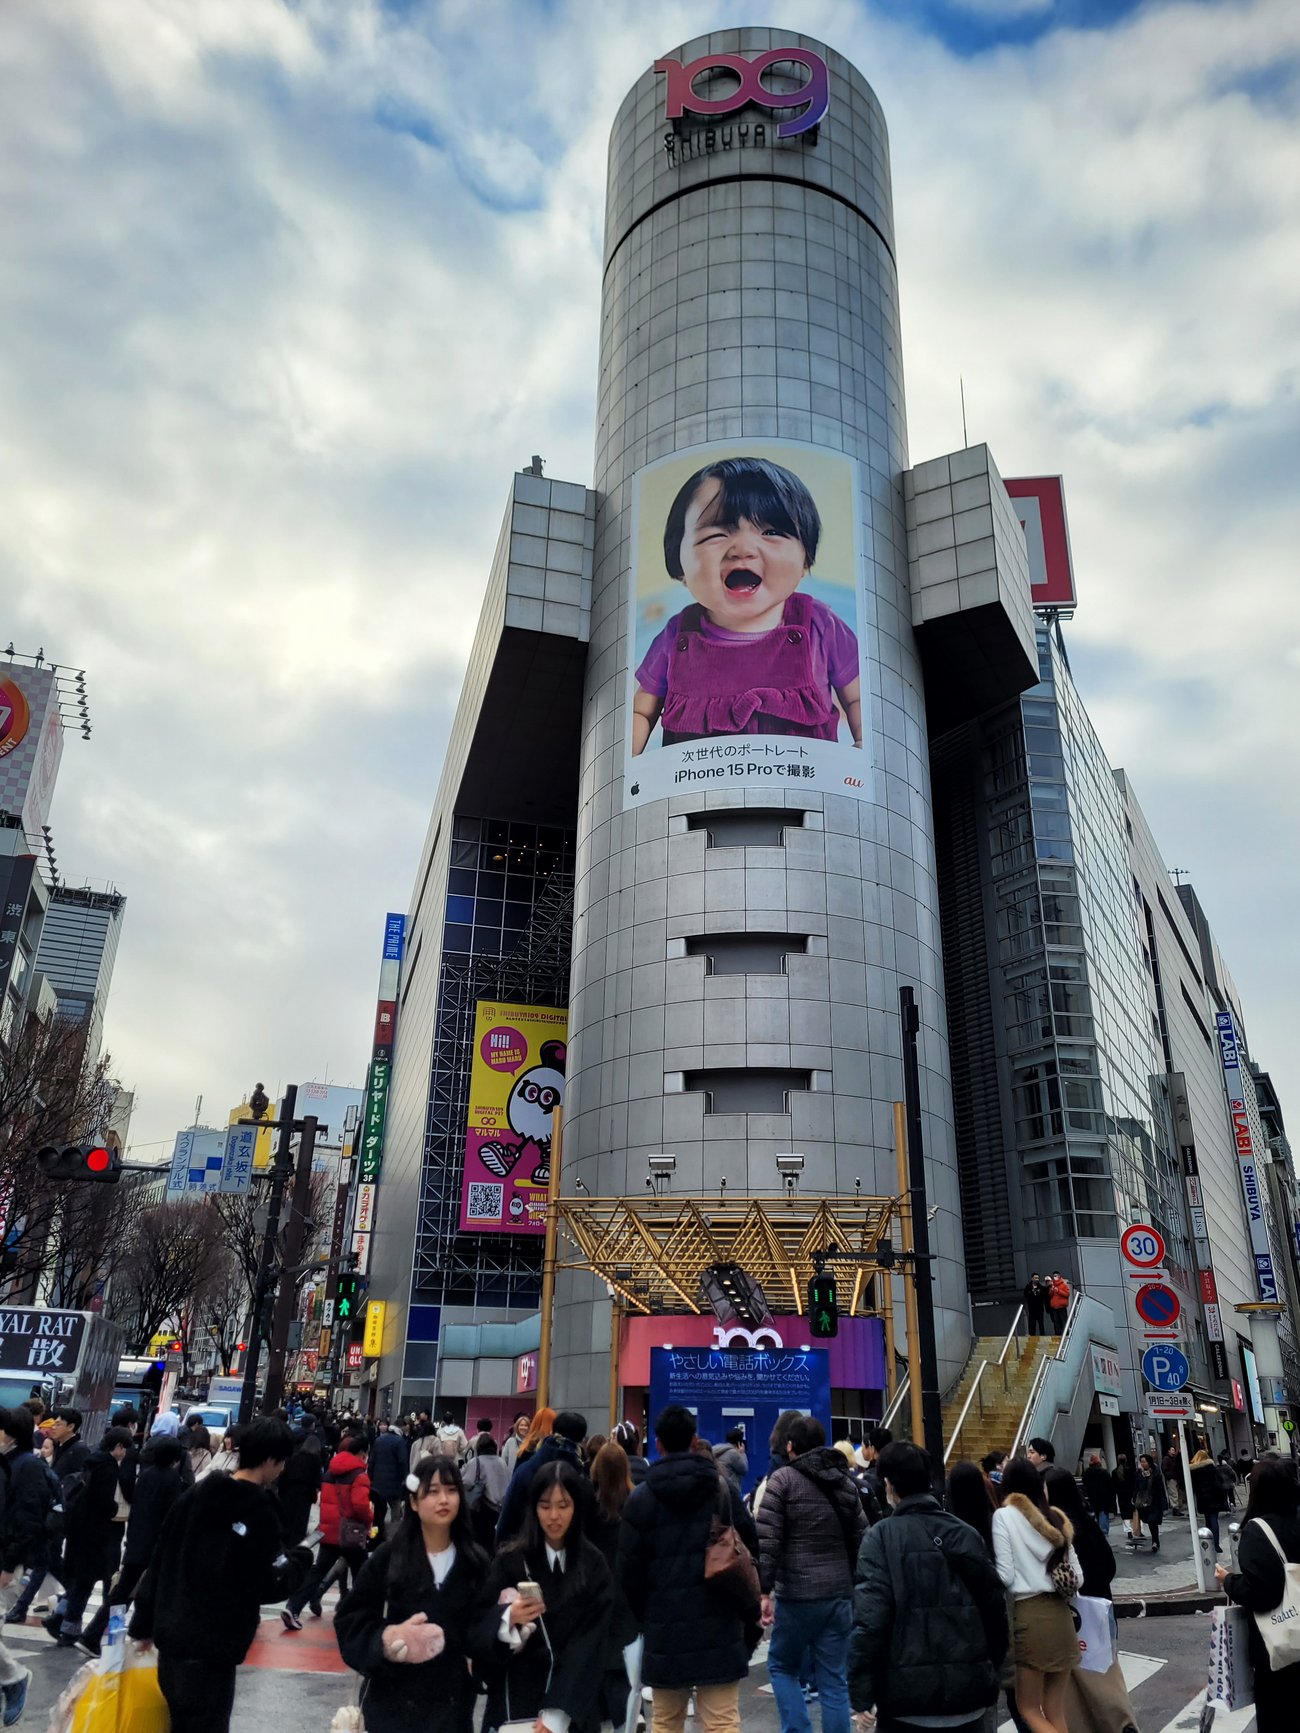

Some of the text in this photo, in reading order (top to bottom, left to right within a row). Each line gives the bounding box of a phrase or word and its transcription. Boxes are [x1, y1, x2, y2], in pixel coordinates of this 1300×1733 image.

[654, 47, 829, 138] 109
[663, 123, 766, 151] SHIBUYA
[682, 744, 809, 764] 次世代のポートレート
[674, 767, 725, 784] iPhone
[729, 763, 744, 776] 15
[844, 776, 864, 788] au
[386, 920, 401, 958] THE PRIME
[490, 1033, 510, 1049] Hi!!
[1220, 1030, 1238, 1066] LABI
[363, 1065, 387, 1173] ビリヤード・ダーツ
[474, 1128, 501, 1138] マルマル
[1233, 1112, 1254, 1155] LABI
[172, 1133, 191, 1189] スクランブル式
[233, 1131, 253, 1188] 道玄坂下
[363, 1174, 373, 1182] 3F
[1243, 1166, 1261, 1221] SHIBUYA
[1130, 1237, 1155, 1256] 30
[35, 1315, 78, 1336] RAT
[27, 1338, 67, 1367] 散
[1154, 1346, 1174, 1355] 7-20
[669, 1353, 810, 1372] やさしい電話ボックス
[1152, 1356, 1171, 1386] P
[1270, 1605, 1299, 1626] Salut!
[1217, 1659, 1223, 1675] UP
[1216, 1677, 1224, 1700] POP
